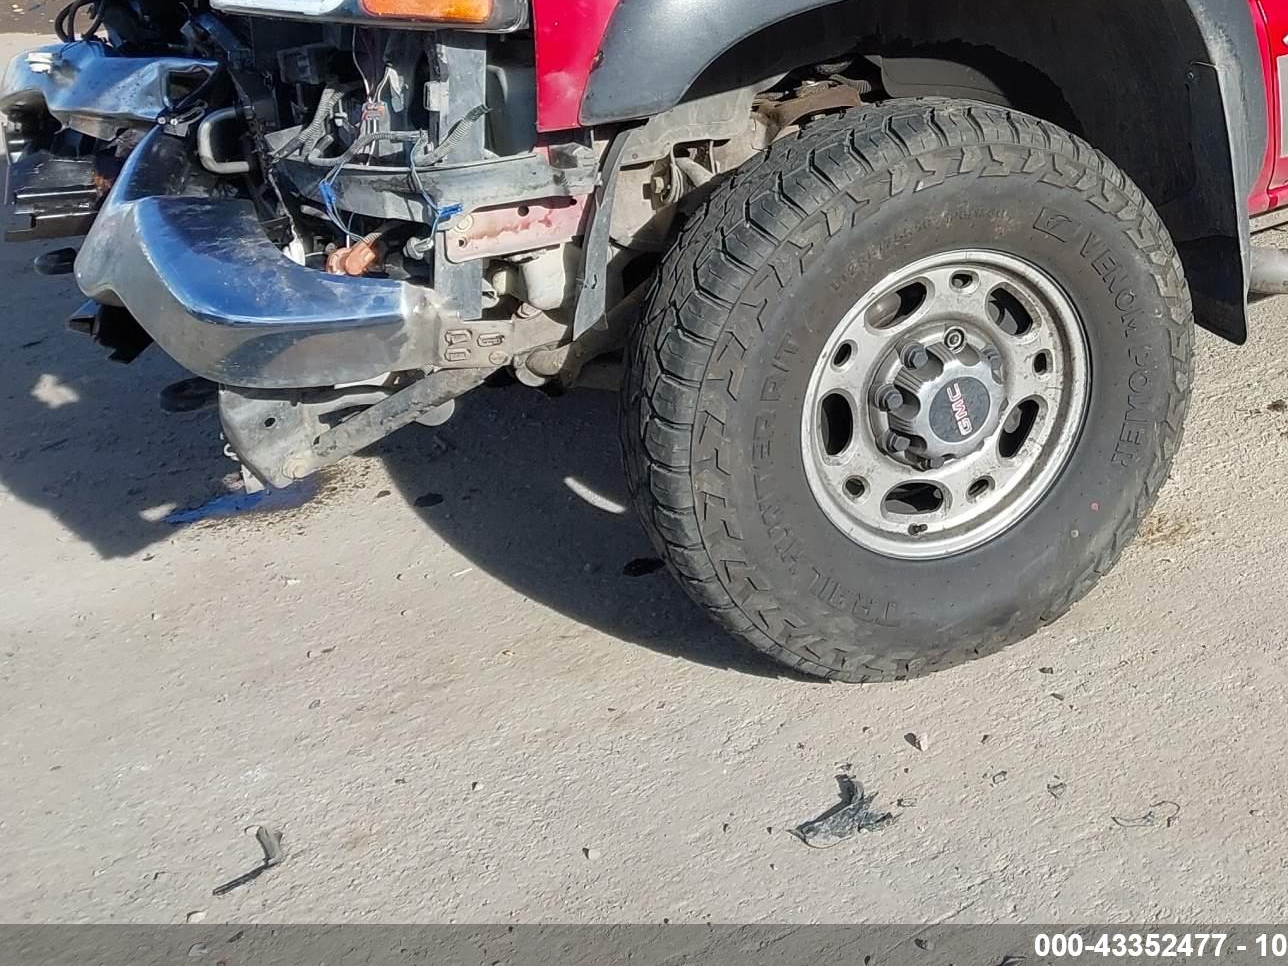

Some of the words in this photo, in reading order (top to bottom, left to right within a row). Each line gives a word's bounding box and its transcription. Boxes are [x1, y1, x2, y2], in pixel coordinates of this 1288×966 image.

[1079, 230, 1144, 339] VENOM
[946, 382, 973, 436] GMC
[1110, 344, 1153, 468] POWER
